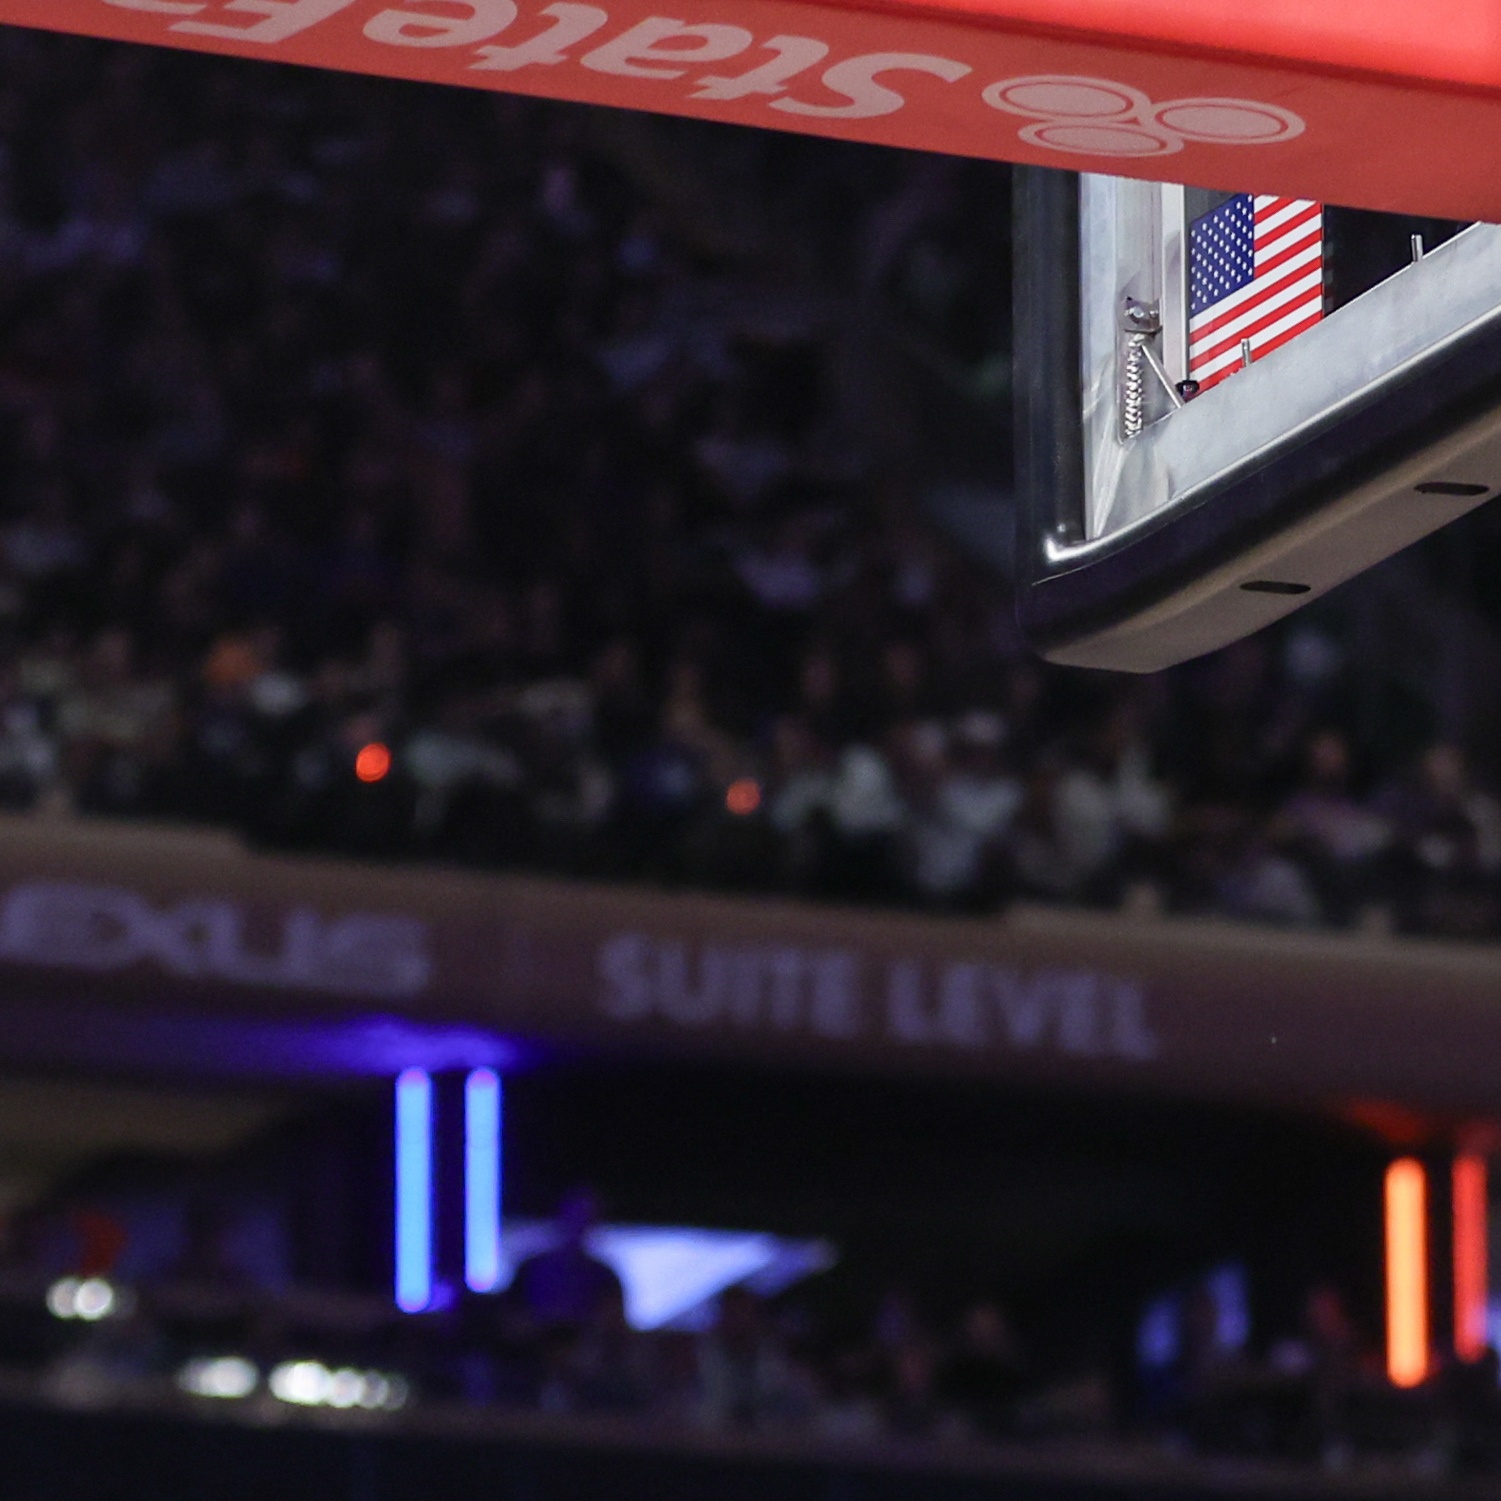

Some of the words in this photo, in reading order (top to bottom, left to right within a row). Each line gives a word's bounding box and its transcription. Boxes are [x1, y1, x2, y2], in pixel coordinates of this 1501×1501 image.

[0, 882, 428, 998] EXUS
[600, 932, 860, 1040] SUITE
[888, 958, 1158, 1063] LEVEL
